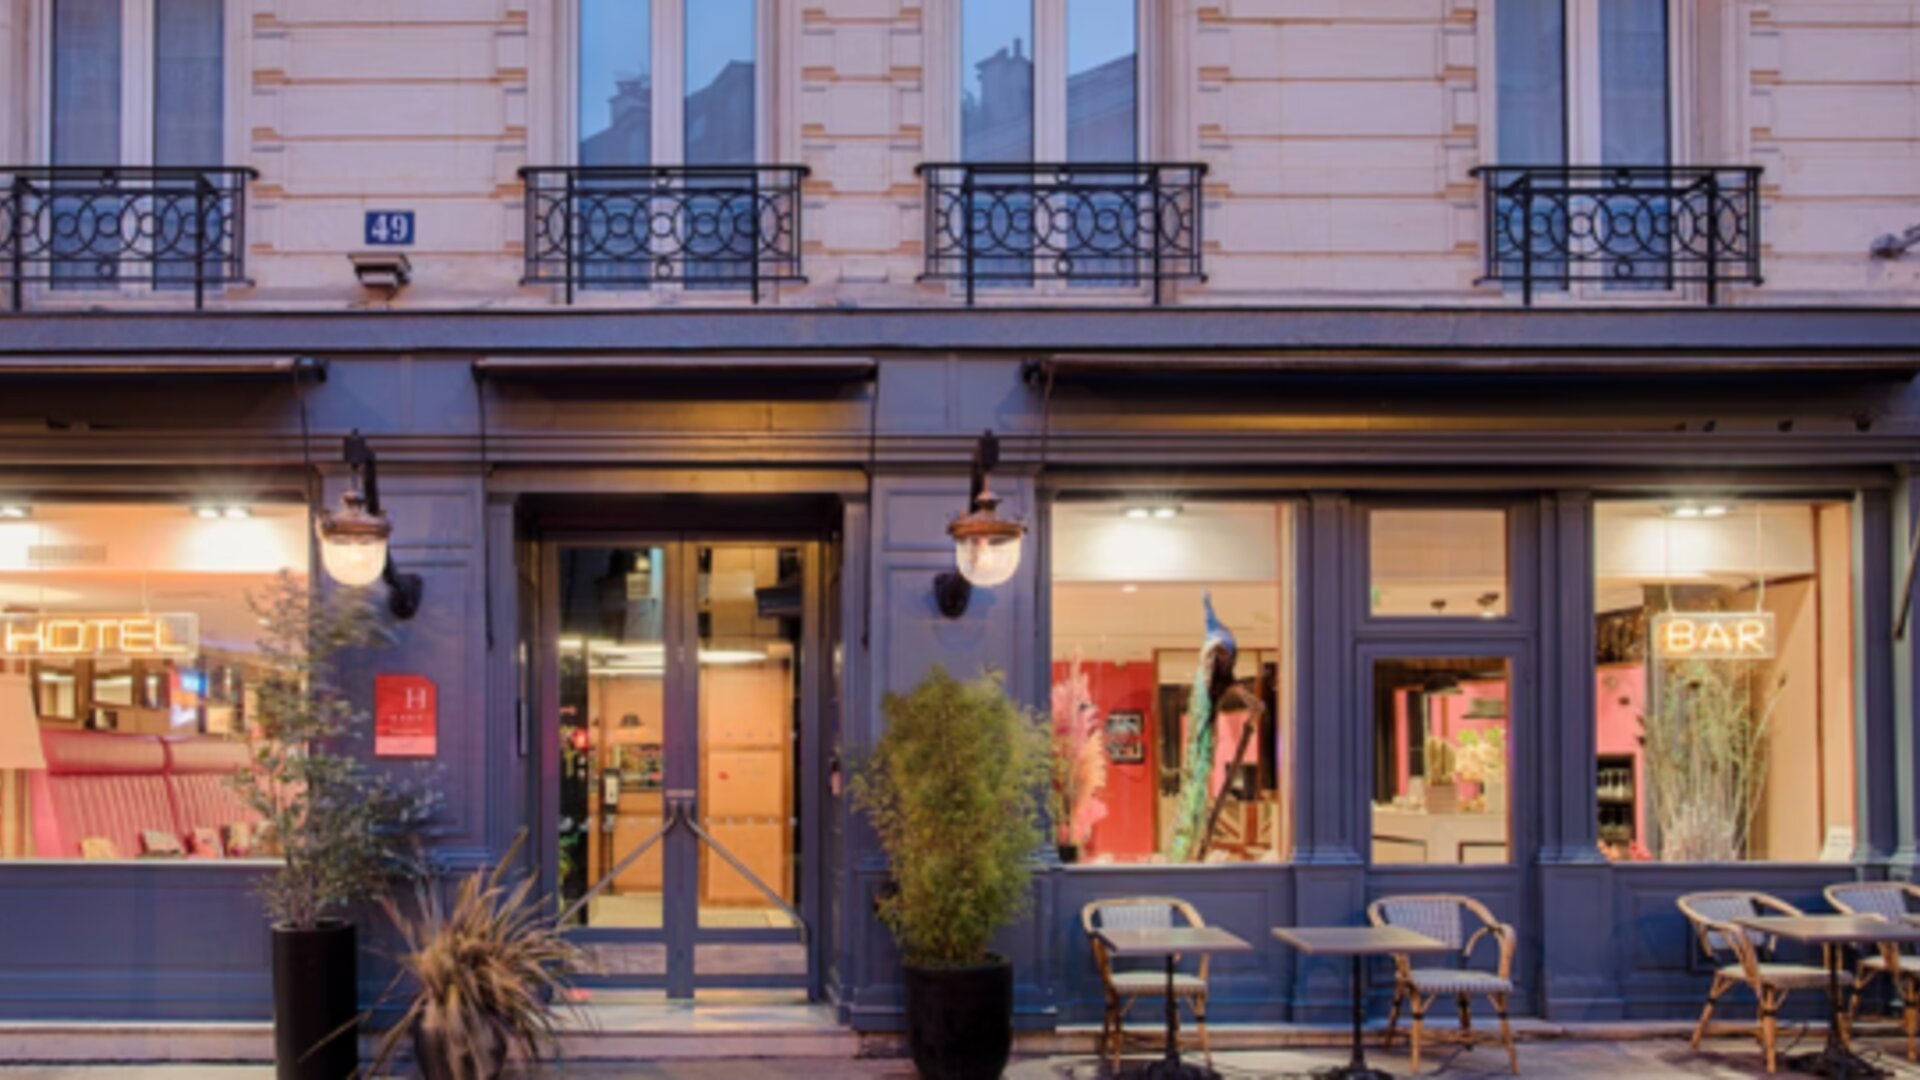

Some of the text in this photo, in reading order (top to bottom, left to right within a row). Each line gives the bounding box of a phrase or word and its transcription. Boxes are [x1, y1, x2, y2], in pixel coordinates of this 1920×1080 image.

[371, 214, 408, 242] 49
[5, 618, 188, 654] HOTEL
[1667, 619, 1765, 652] BAR
[406, 686, 427, 710] H
